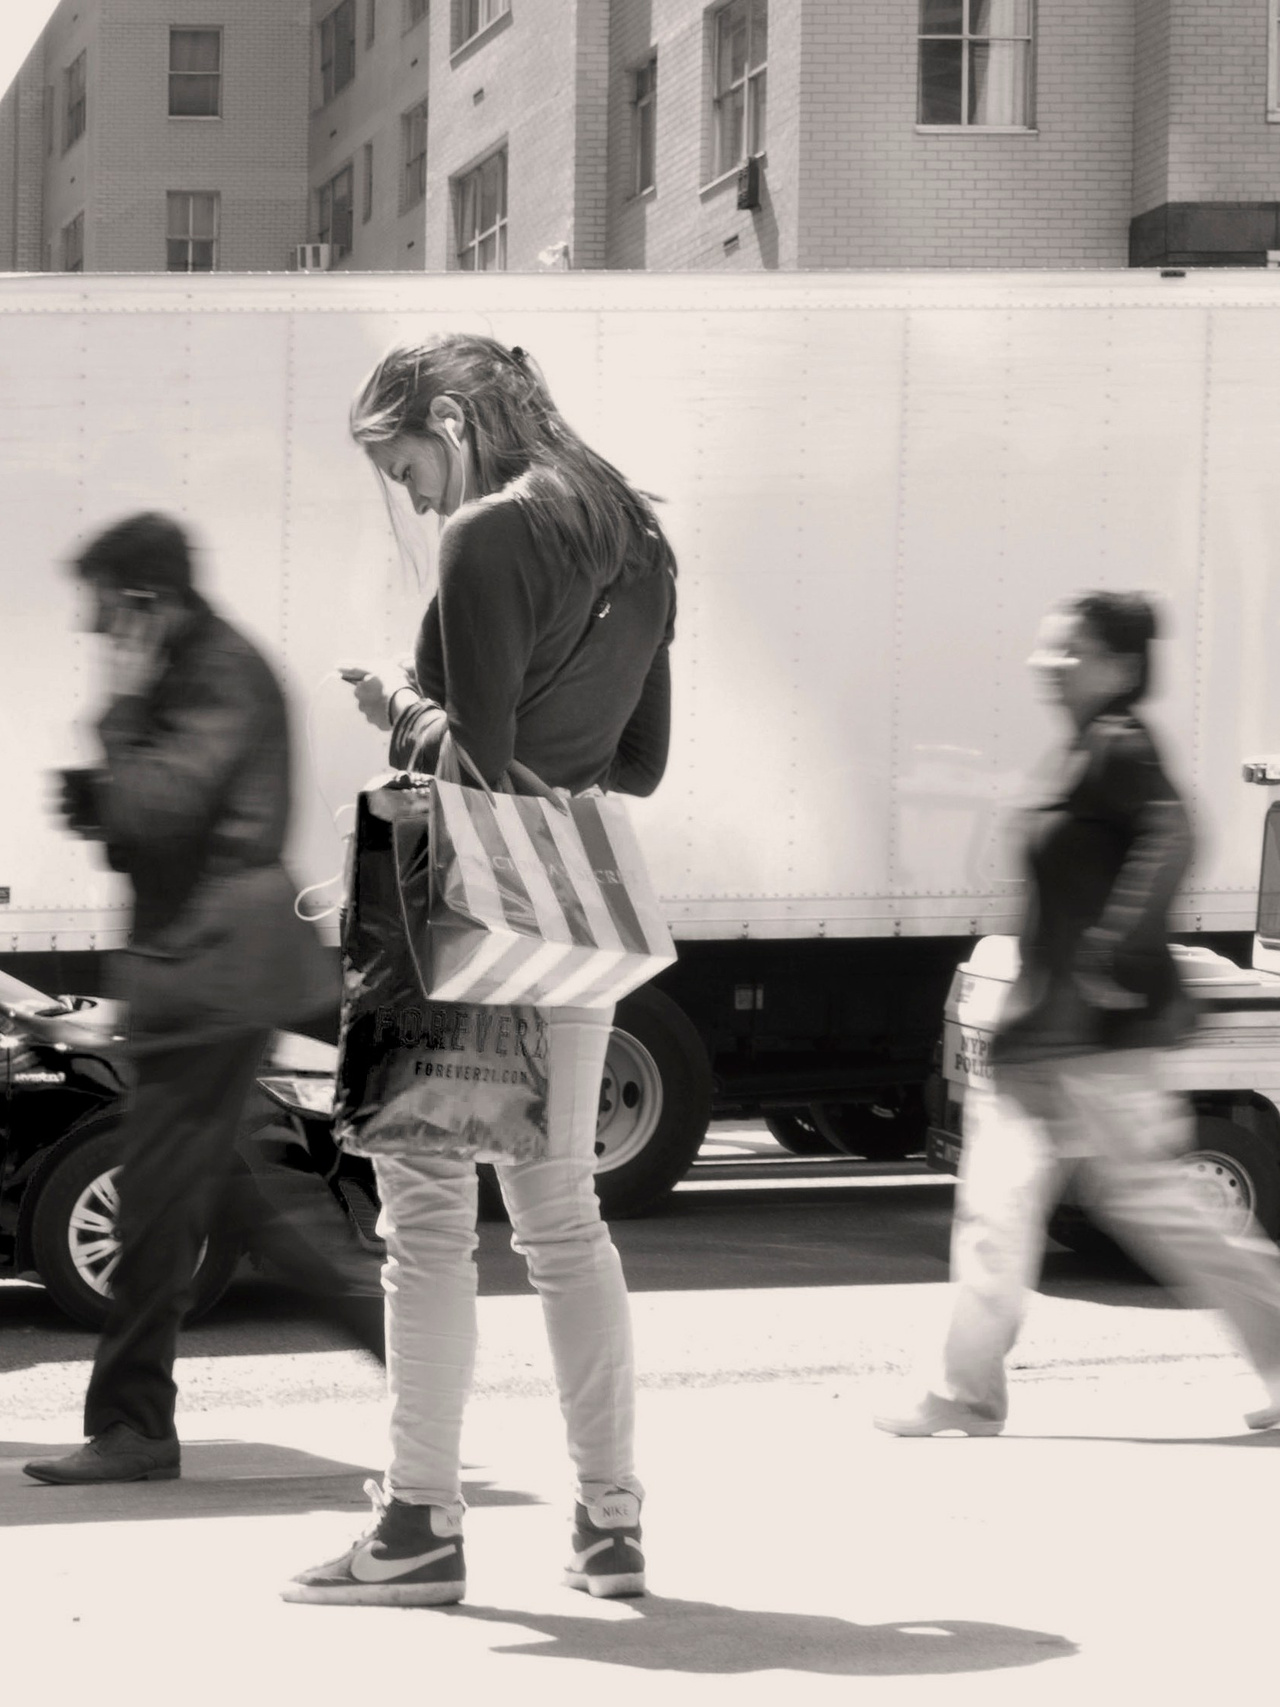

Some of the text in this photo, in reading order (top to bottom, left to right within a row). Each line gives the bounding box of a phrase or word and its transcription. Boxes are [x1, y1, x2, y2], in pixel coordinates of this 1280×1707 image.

[373, 1005, 528, 1057] FOREVER
[961, 1035, 990, 1057] NYP
[414, 1061, 528, 1085] FOREVER21.COM
[955, 1053, 994, 1080] POLIC
[602, 1503, 630, 1519] NIKE
